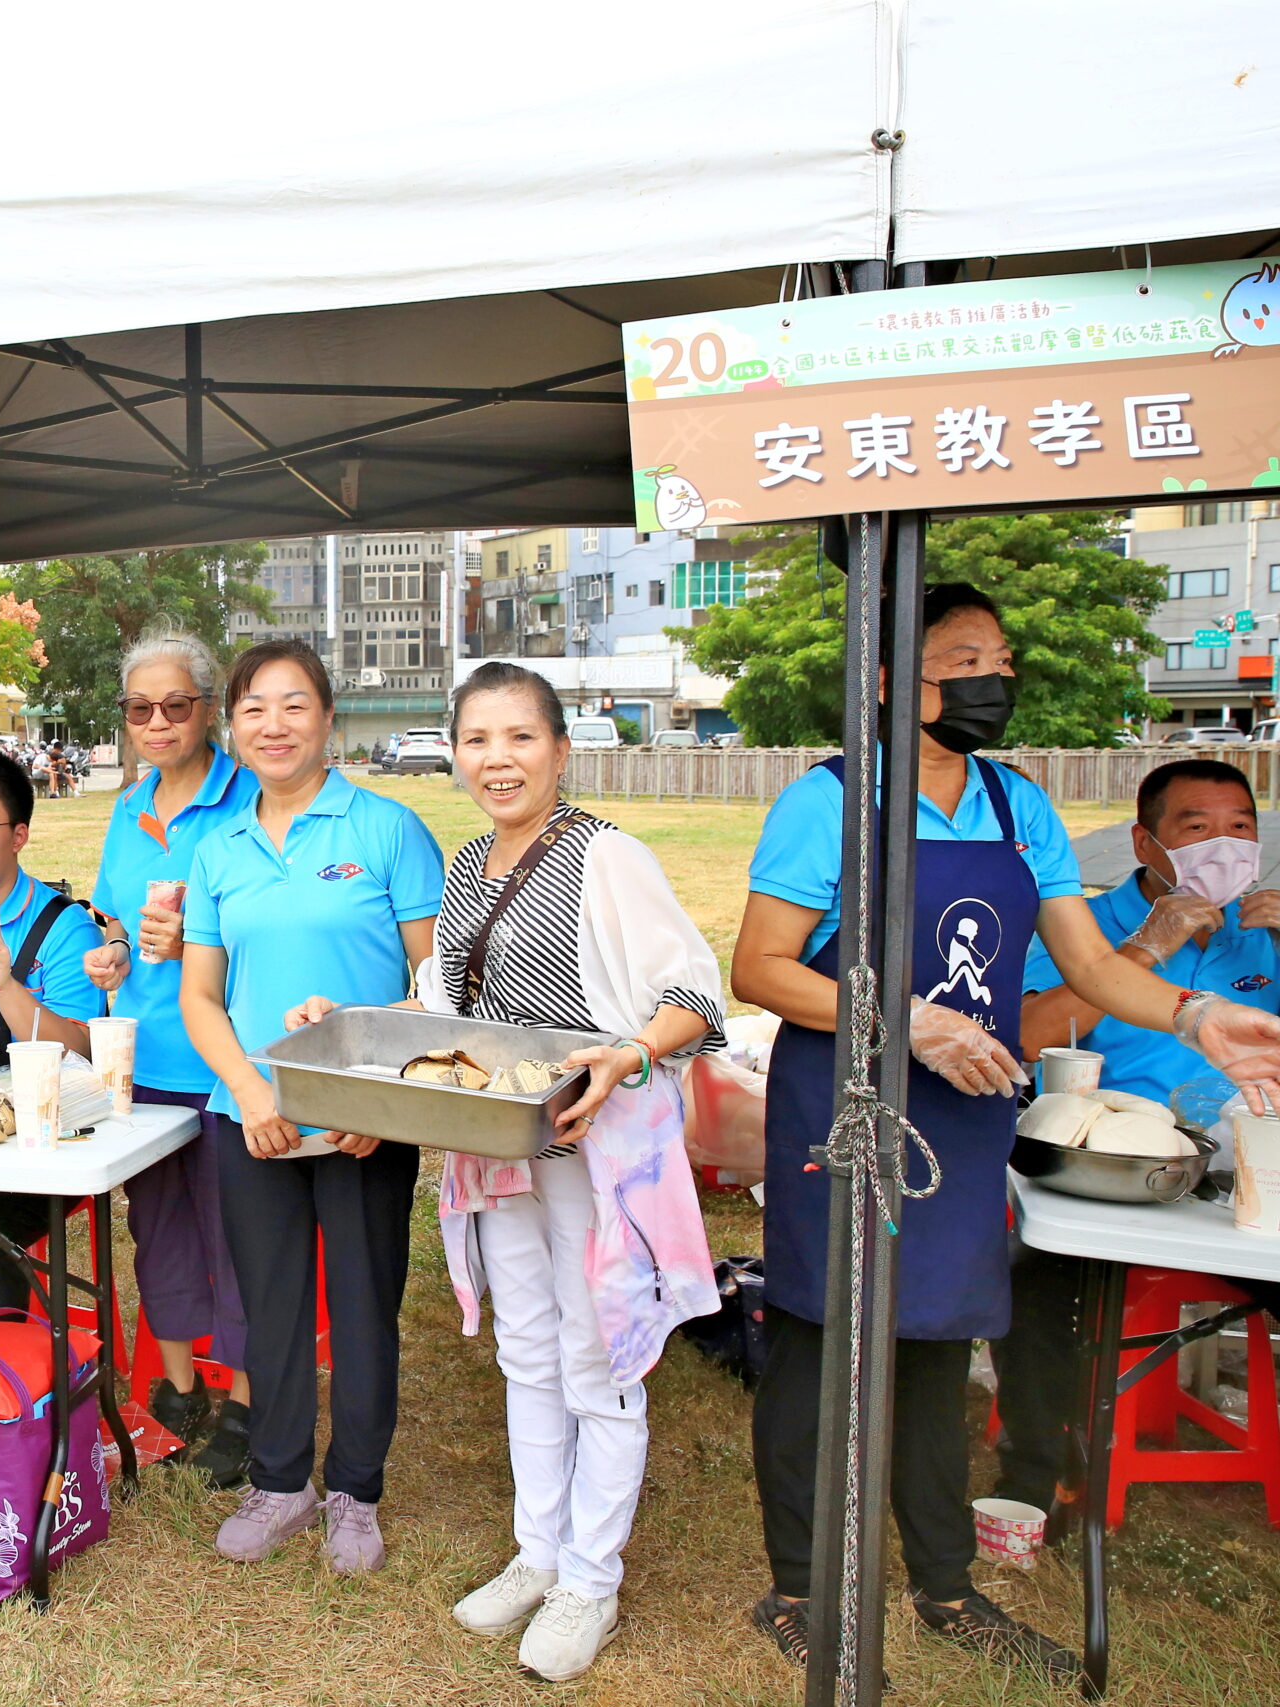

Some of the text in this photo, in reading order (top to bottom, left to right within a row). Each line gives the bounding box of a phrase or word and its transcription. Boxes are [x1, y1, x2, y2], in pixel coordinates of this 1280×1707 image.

[650, 332, 727, 388] 20
[754, 392, 1201, 488] 安東教孝區
